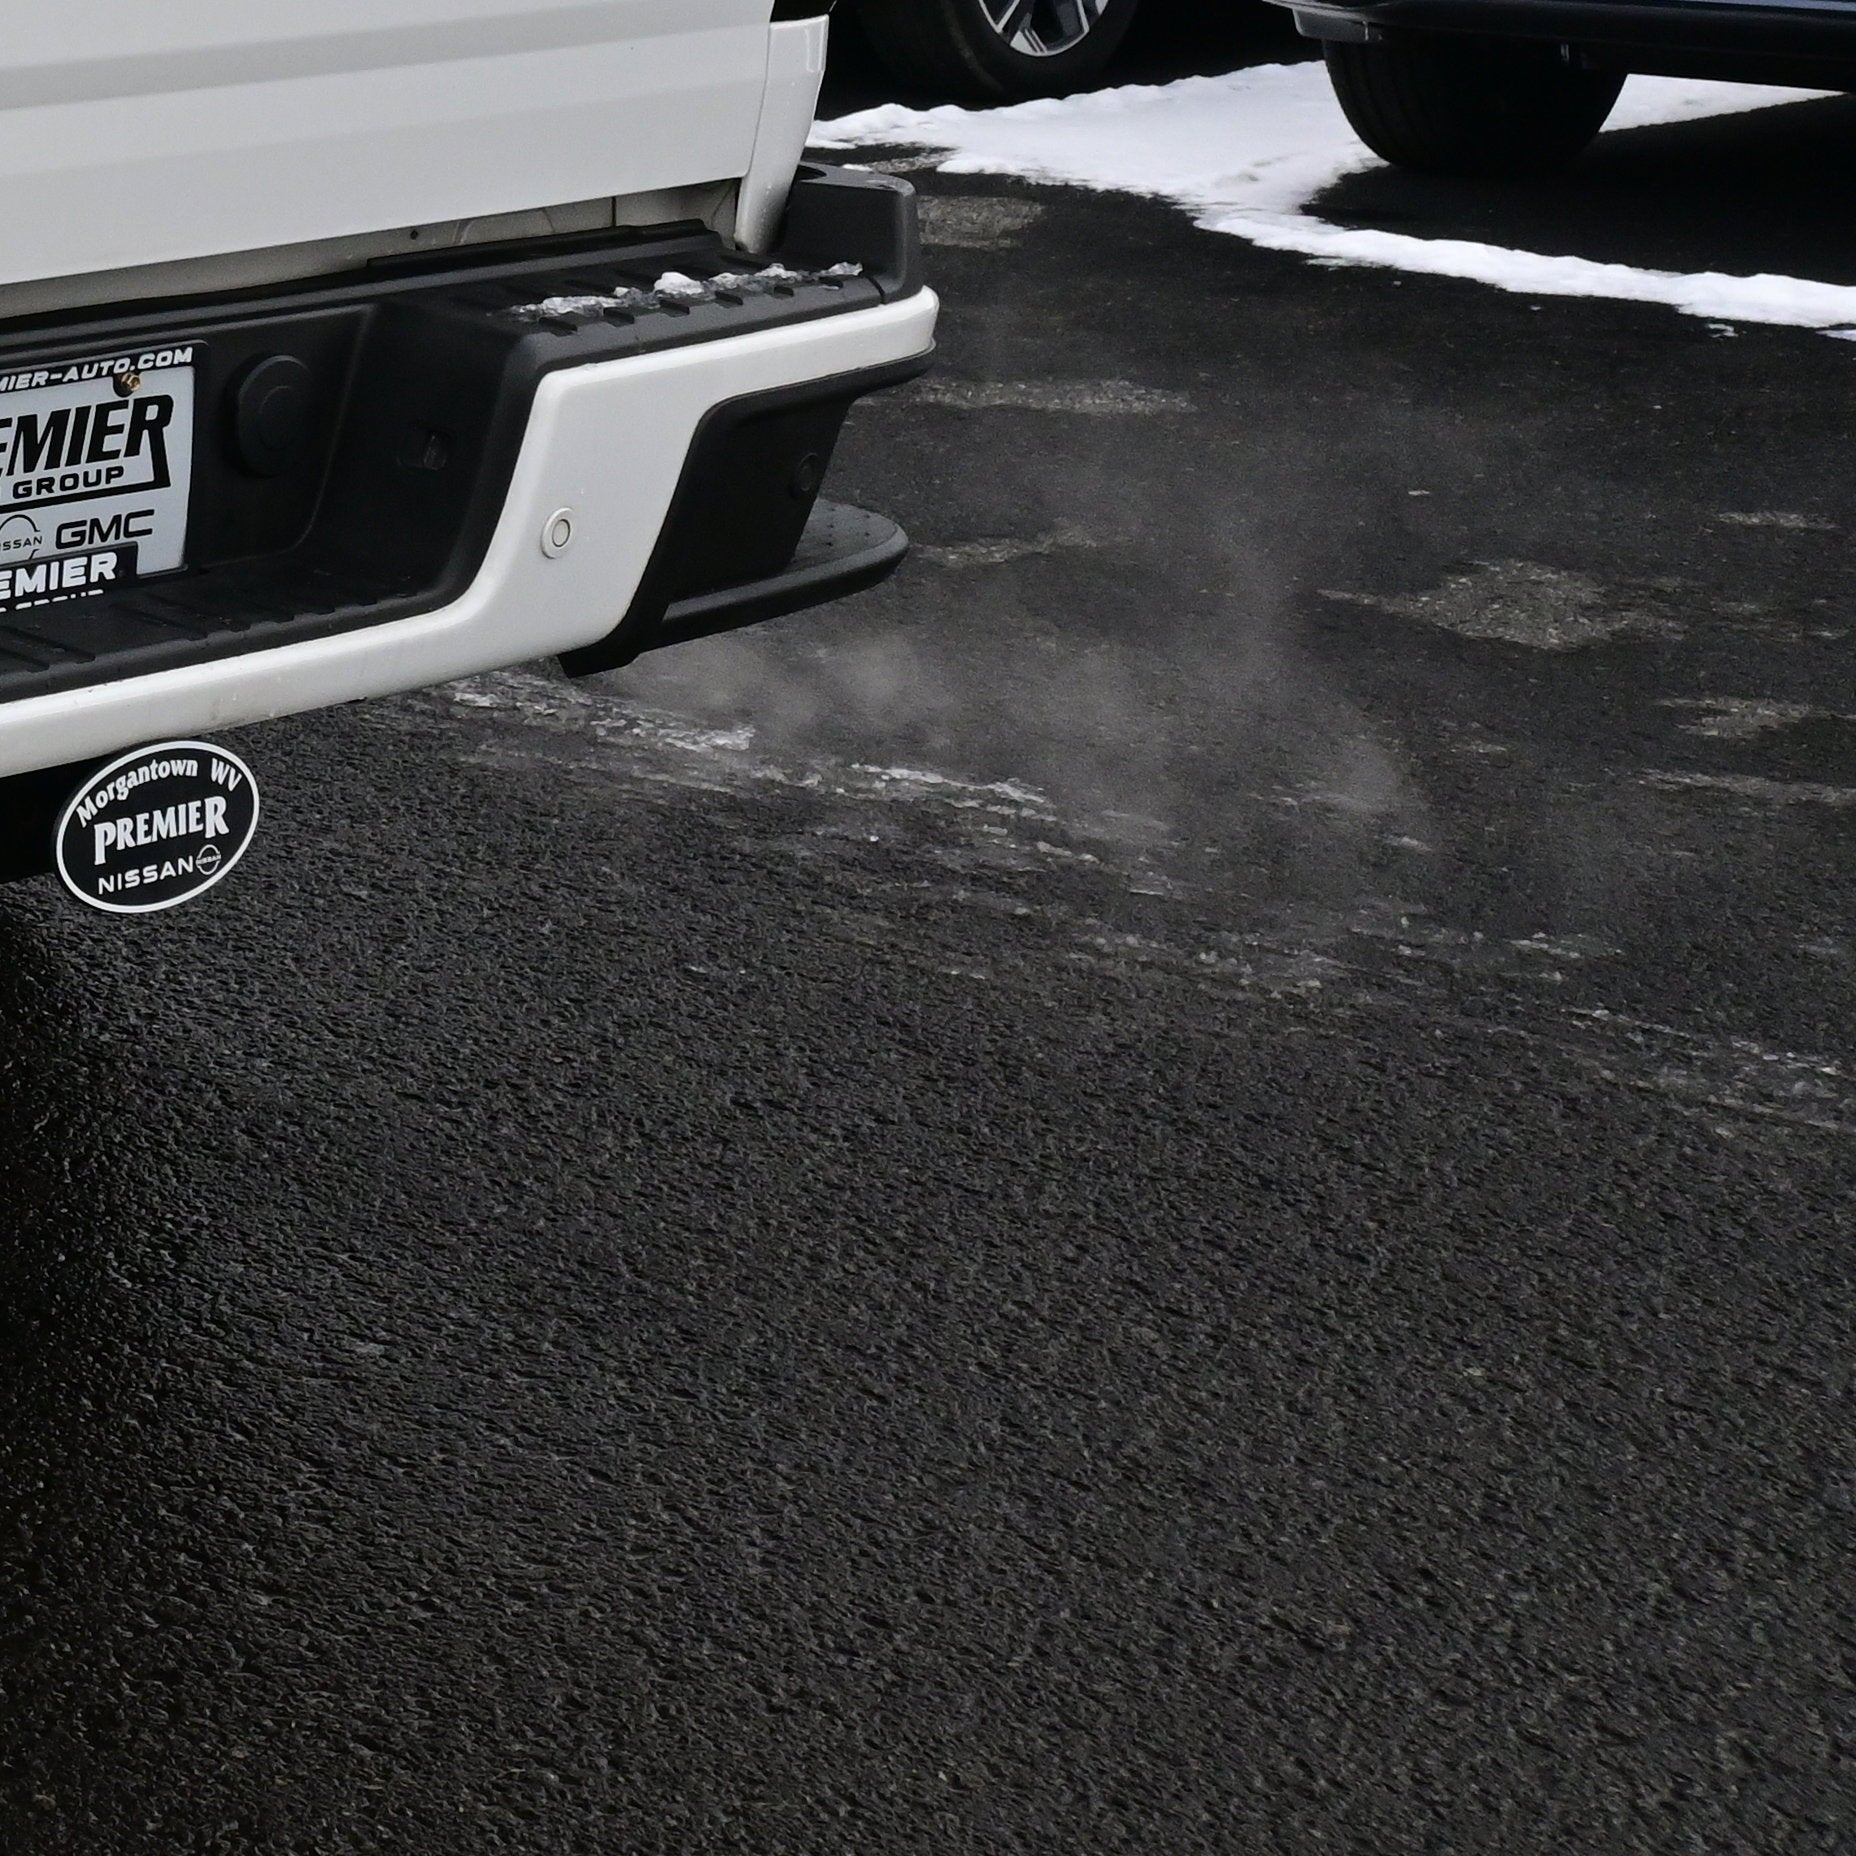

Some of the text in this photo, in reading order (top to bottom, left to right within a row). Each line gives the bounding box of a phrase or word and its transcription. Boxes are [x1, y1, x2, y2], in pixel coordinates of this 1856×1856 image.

[12, 465, 124, 500] GROUP
[55, 509, 155, 550] GMC
[75, 758, 242, 828] Morgantown WV
[94, 796, 230, 866] PREMIER
[98, 855, 194, 895] NISSAN
